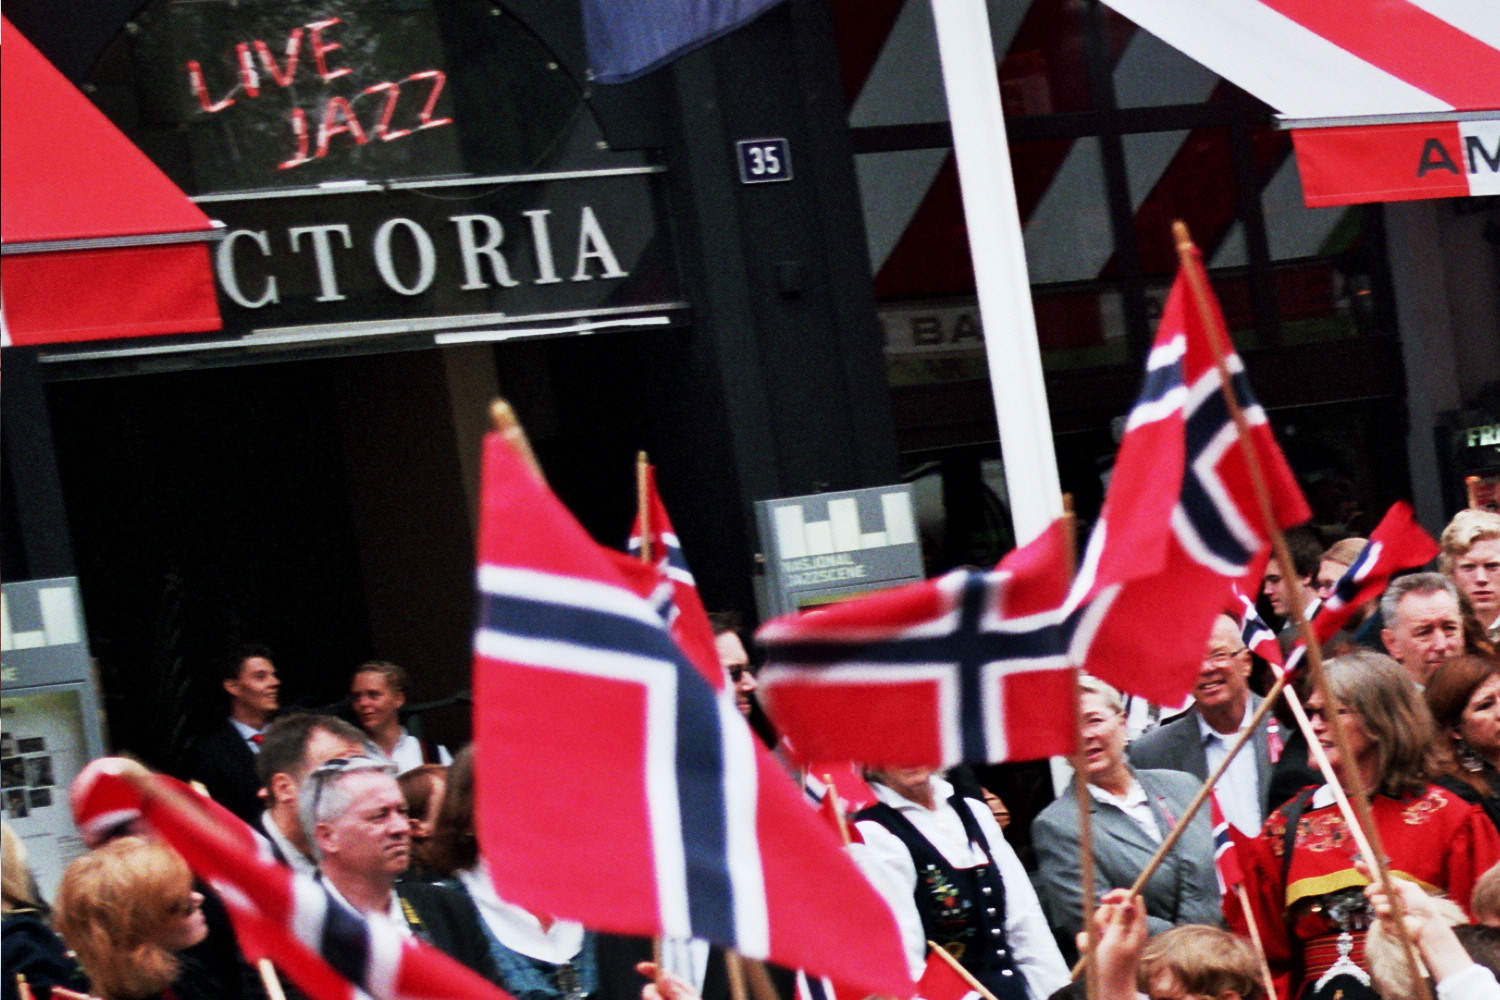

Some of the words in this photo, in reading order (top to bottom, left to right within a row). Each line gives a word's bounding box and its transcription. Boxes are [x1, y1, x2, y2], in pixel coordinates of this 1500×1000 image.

[187, 17, 353, 112] LIVE
[277, 70, 453, 170] JAZZ
[749, 146, 781, 175] 35
[217, 207, 629, 309] CTORIA
